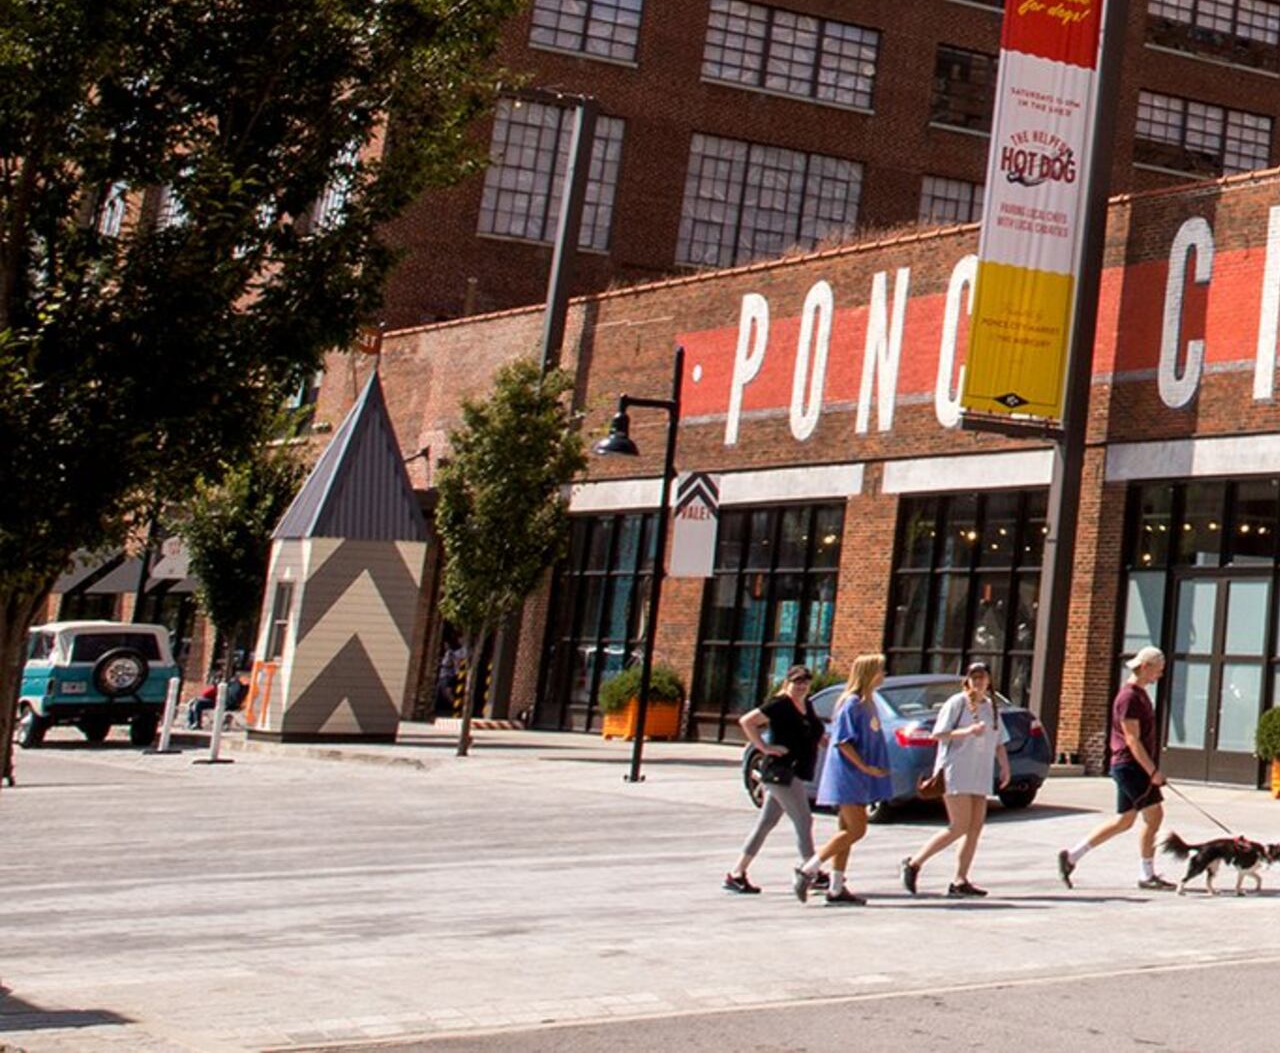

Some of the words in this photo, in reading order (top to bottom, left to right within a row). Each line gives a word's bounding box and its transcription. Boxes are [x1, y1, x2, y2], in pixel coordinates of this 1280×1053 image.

[1047, 2, 1091, 26] dogs!
[1010, 131, 1029, 147] THE
[1001, 146, 1037, 177] HOT
[1039, 153, 1076, 184] DOG
[724, 254, 979, 446] PONC
